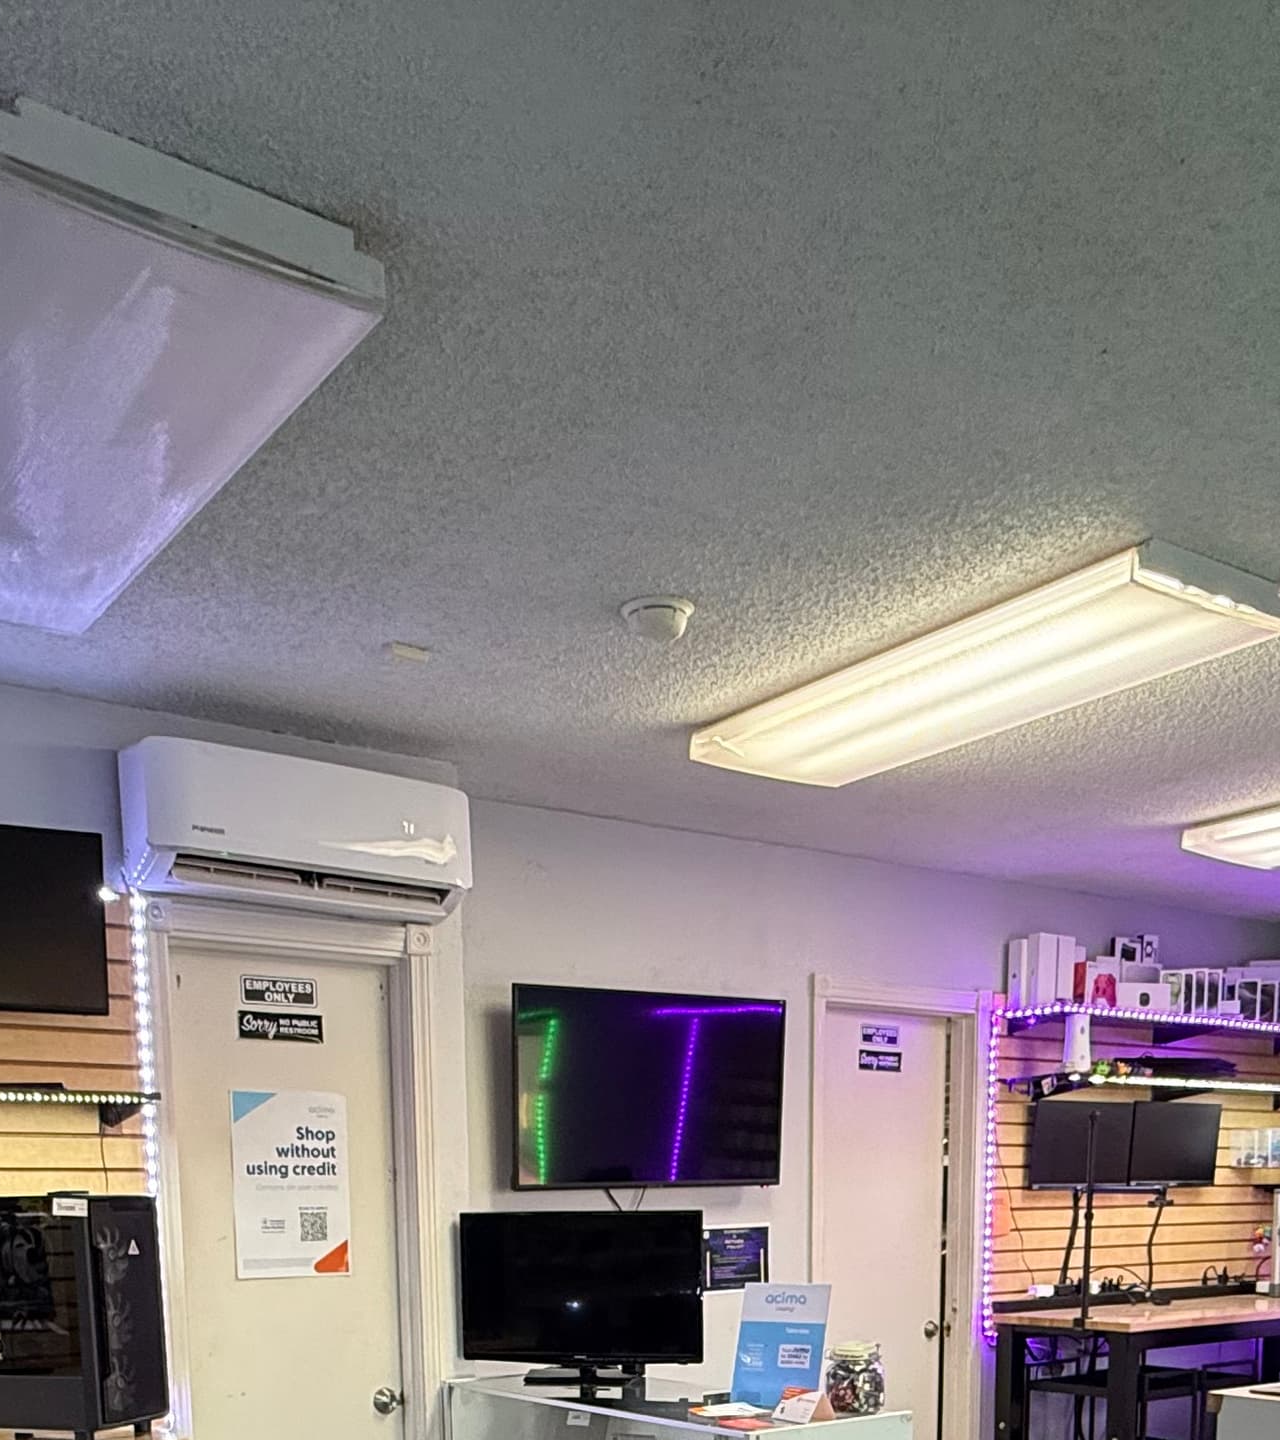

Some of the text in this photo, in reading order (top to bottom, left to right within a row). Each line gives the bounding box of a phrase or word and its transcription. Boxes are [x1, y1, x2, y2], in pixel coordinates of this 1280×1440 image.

[245, 979, 313, 994] EMPLOYEES
[264, 991, 295, 1003] ONLY
[240, 1014, 278, 1040] Sorry
[291, 1019, 318, 1028] PUBLIC
[279, 1027, 320, 1036] RESTROOM
[295, 1125, 336, 1144] Shop
[275, 1143, 337, 1159] without
[246, 1160, 337, 1179] using credit
[764, 1291, 807, 1305] acima
